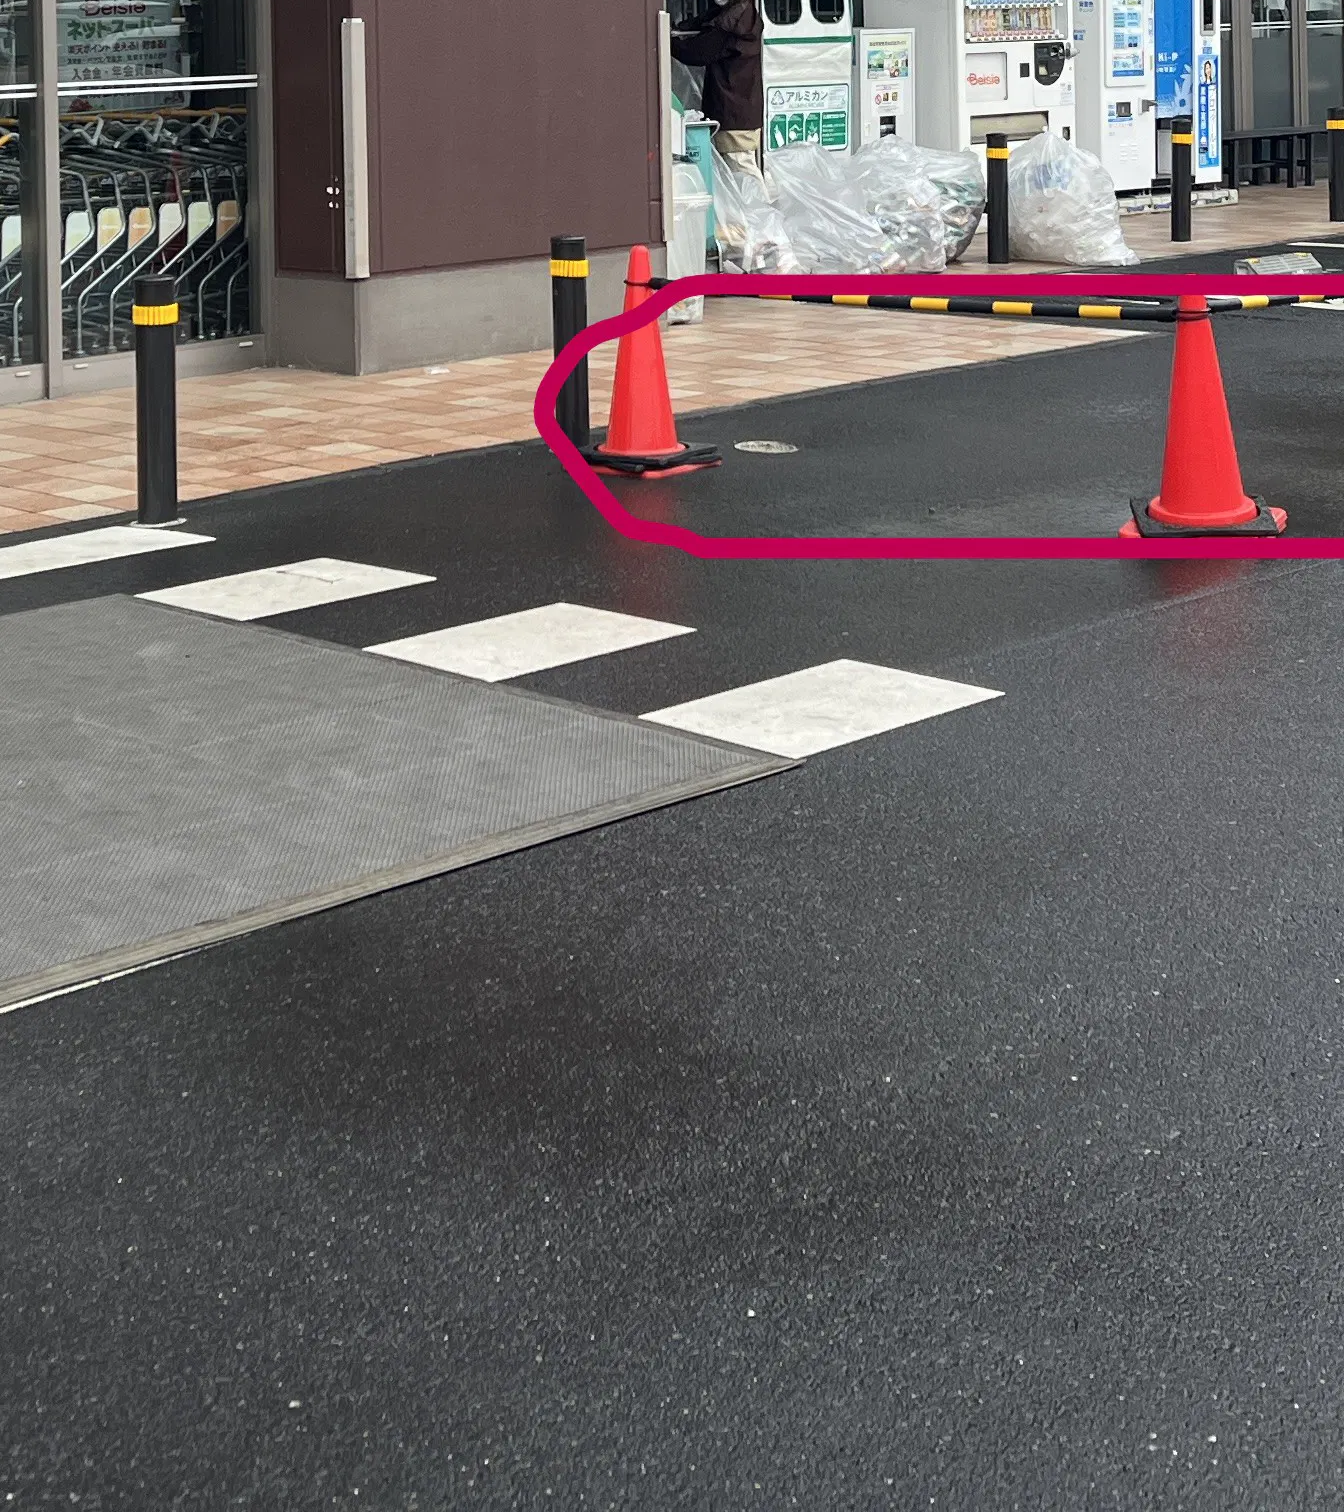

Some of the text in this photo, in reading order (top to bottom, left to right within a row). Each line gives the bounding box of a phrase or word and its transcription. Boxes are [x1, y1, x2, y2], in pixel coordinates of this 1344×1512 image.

[785, 90, 828, 103] アルミカン
